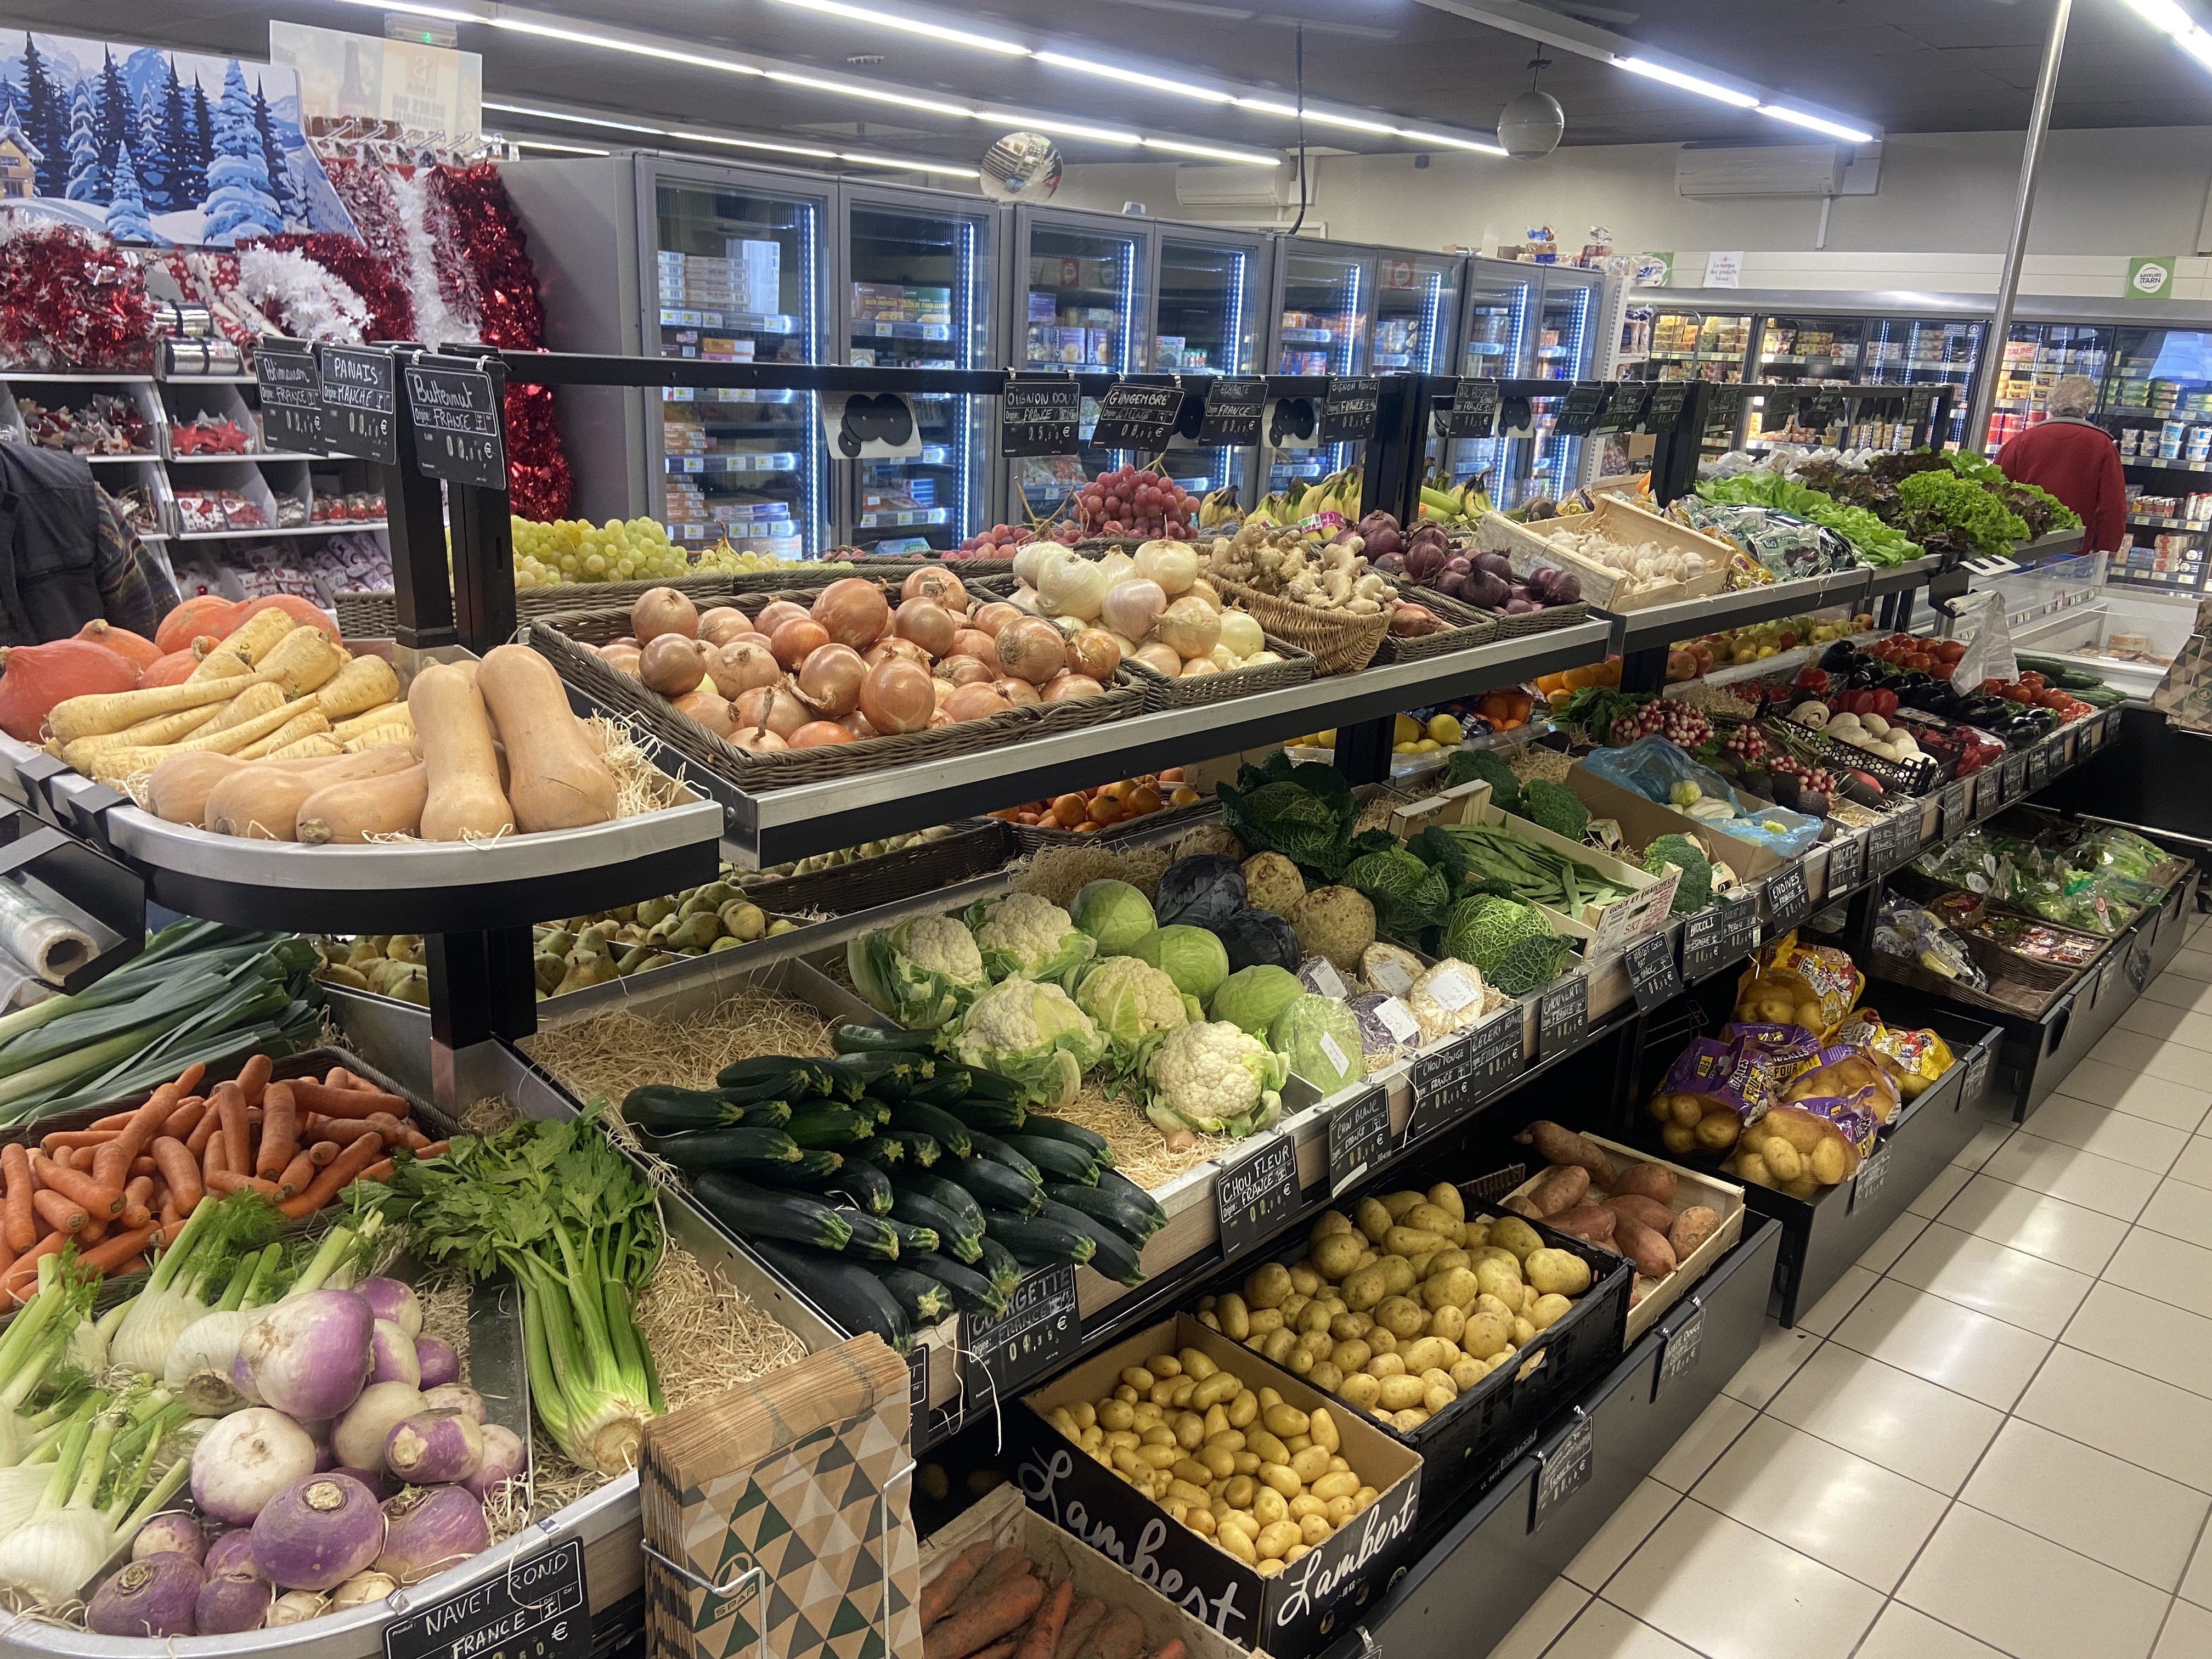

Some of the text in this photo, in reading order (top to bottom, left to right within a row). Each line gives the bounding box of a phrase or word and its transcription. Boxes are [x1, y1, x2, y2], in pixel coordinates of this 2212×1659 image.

[334, 357, 378, 385] PANAIS
[276, 387, 307, 405] FRANCE
[338, 385, 373, 406] MANCHE
[414, 374, 472, 409] Butternut
[1052, 392, 1078, 405] DOUX
[433, 408, 471, 430] FRANCE
[1024, 408, 1053, 421] FRANCE
[1218, 405, 1249, 416] FRANCE
[1631, 895, 1639, 903] ET
[1779, 889, 1795, 907] FRANCE
[1690, 917, 1714, 937] BROCOLI
[1553, 1004, 1573, 1022] FRANCE
[1423, 1048, 1464, 1076] CHOU ROUGE
[1774, 1063, 1797, 1078] FOUR
[1431, 1071, 1453, 1091] FRANCE
[1337, 1099, 1379, 1139] CHOU BLANC
[1345, 1126, 1365, 1150] FRANCE
[1223, 1145, 1289, 1203] CHOU FLEUR
[1242, 1172, 1273, 1205] FRANCE
[973, 1268, 1070, 1336] CORGETTE
[998, 1309, 1047, 1345] FRANCE
[1277, 1481, 1418, 1627] Lambert
[425, 1582, 498, 1636] NAVET
[510, 1553, 568, 1589] ROND
[716, 1585, 754, 1616] SPAR
[451, 1610, 526, 1659] FRANCE
